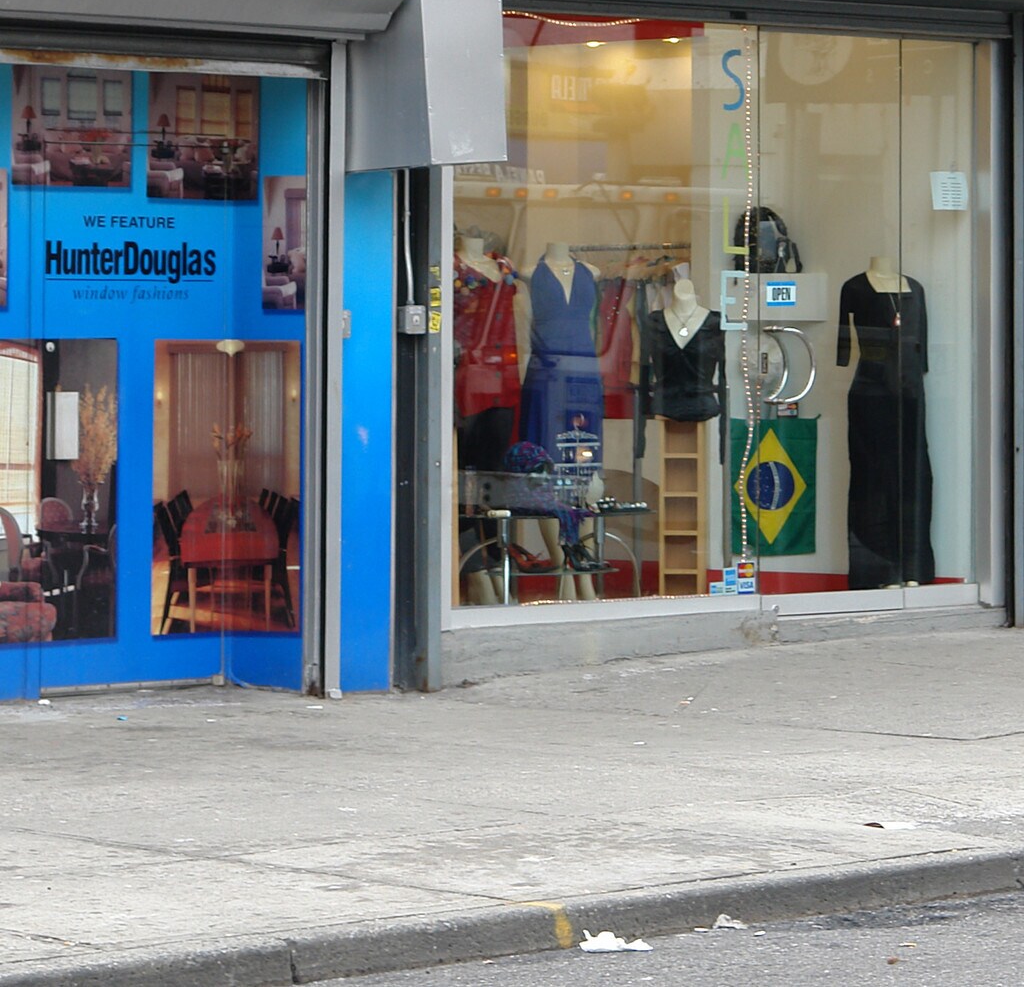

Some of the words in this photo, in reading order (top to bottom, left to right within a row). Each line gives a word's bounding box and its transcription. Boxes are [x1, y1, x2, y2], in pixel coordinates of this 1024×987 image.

[719, 49, 749, 331] SALE
[83, 216, 106, 228] WE
[110, 216, 175, 229] FEATURE
[45, 240, 216, 284] HunterDouglas
[73, 285, 128, 300] window
[130, 285, 189, 304] fashions
[772, 287, 791, 301] OPEN
